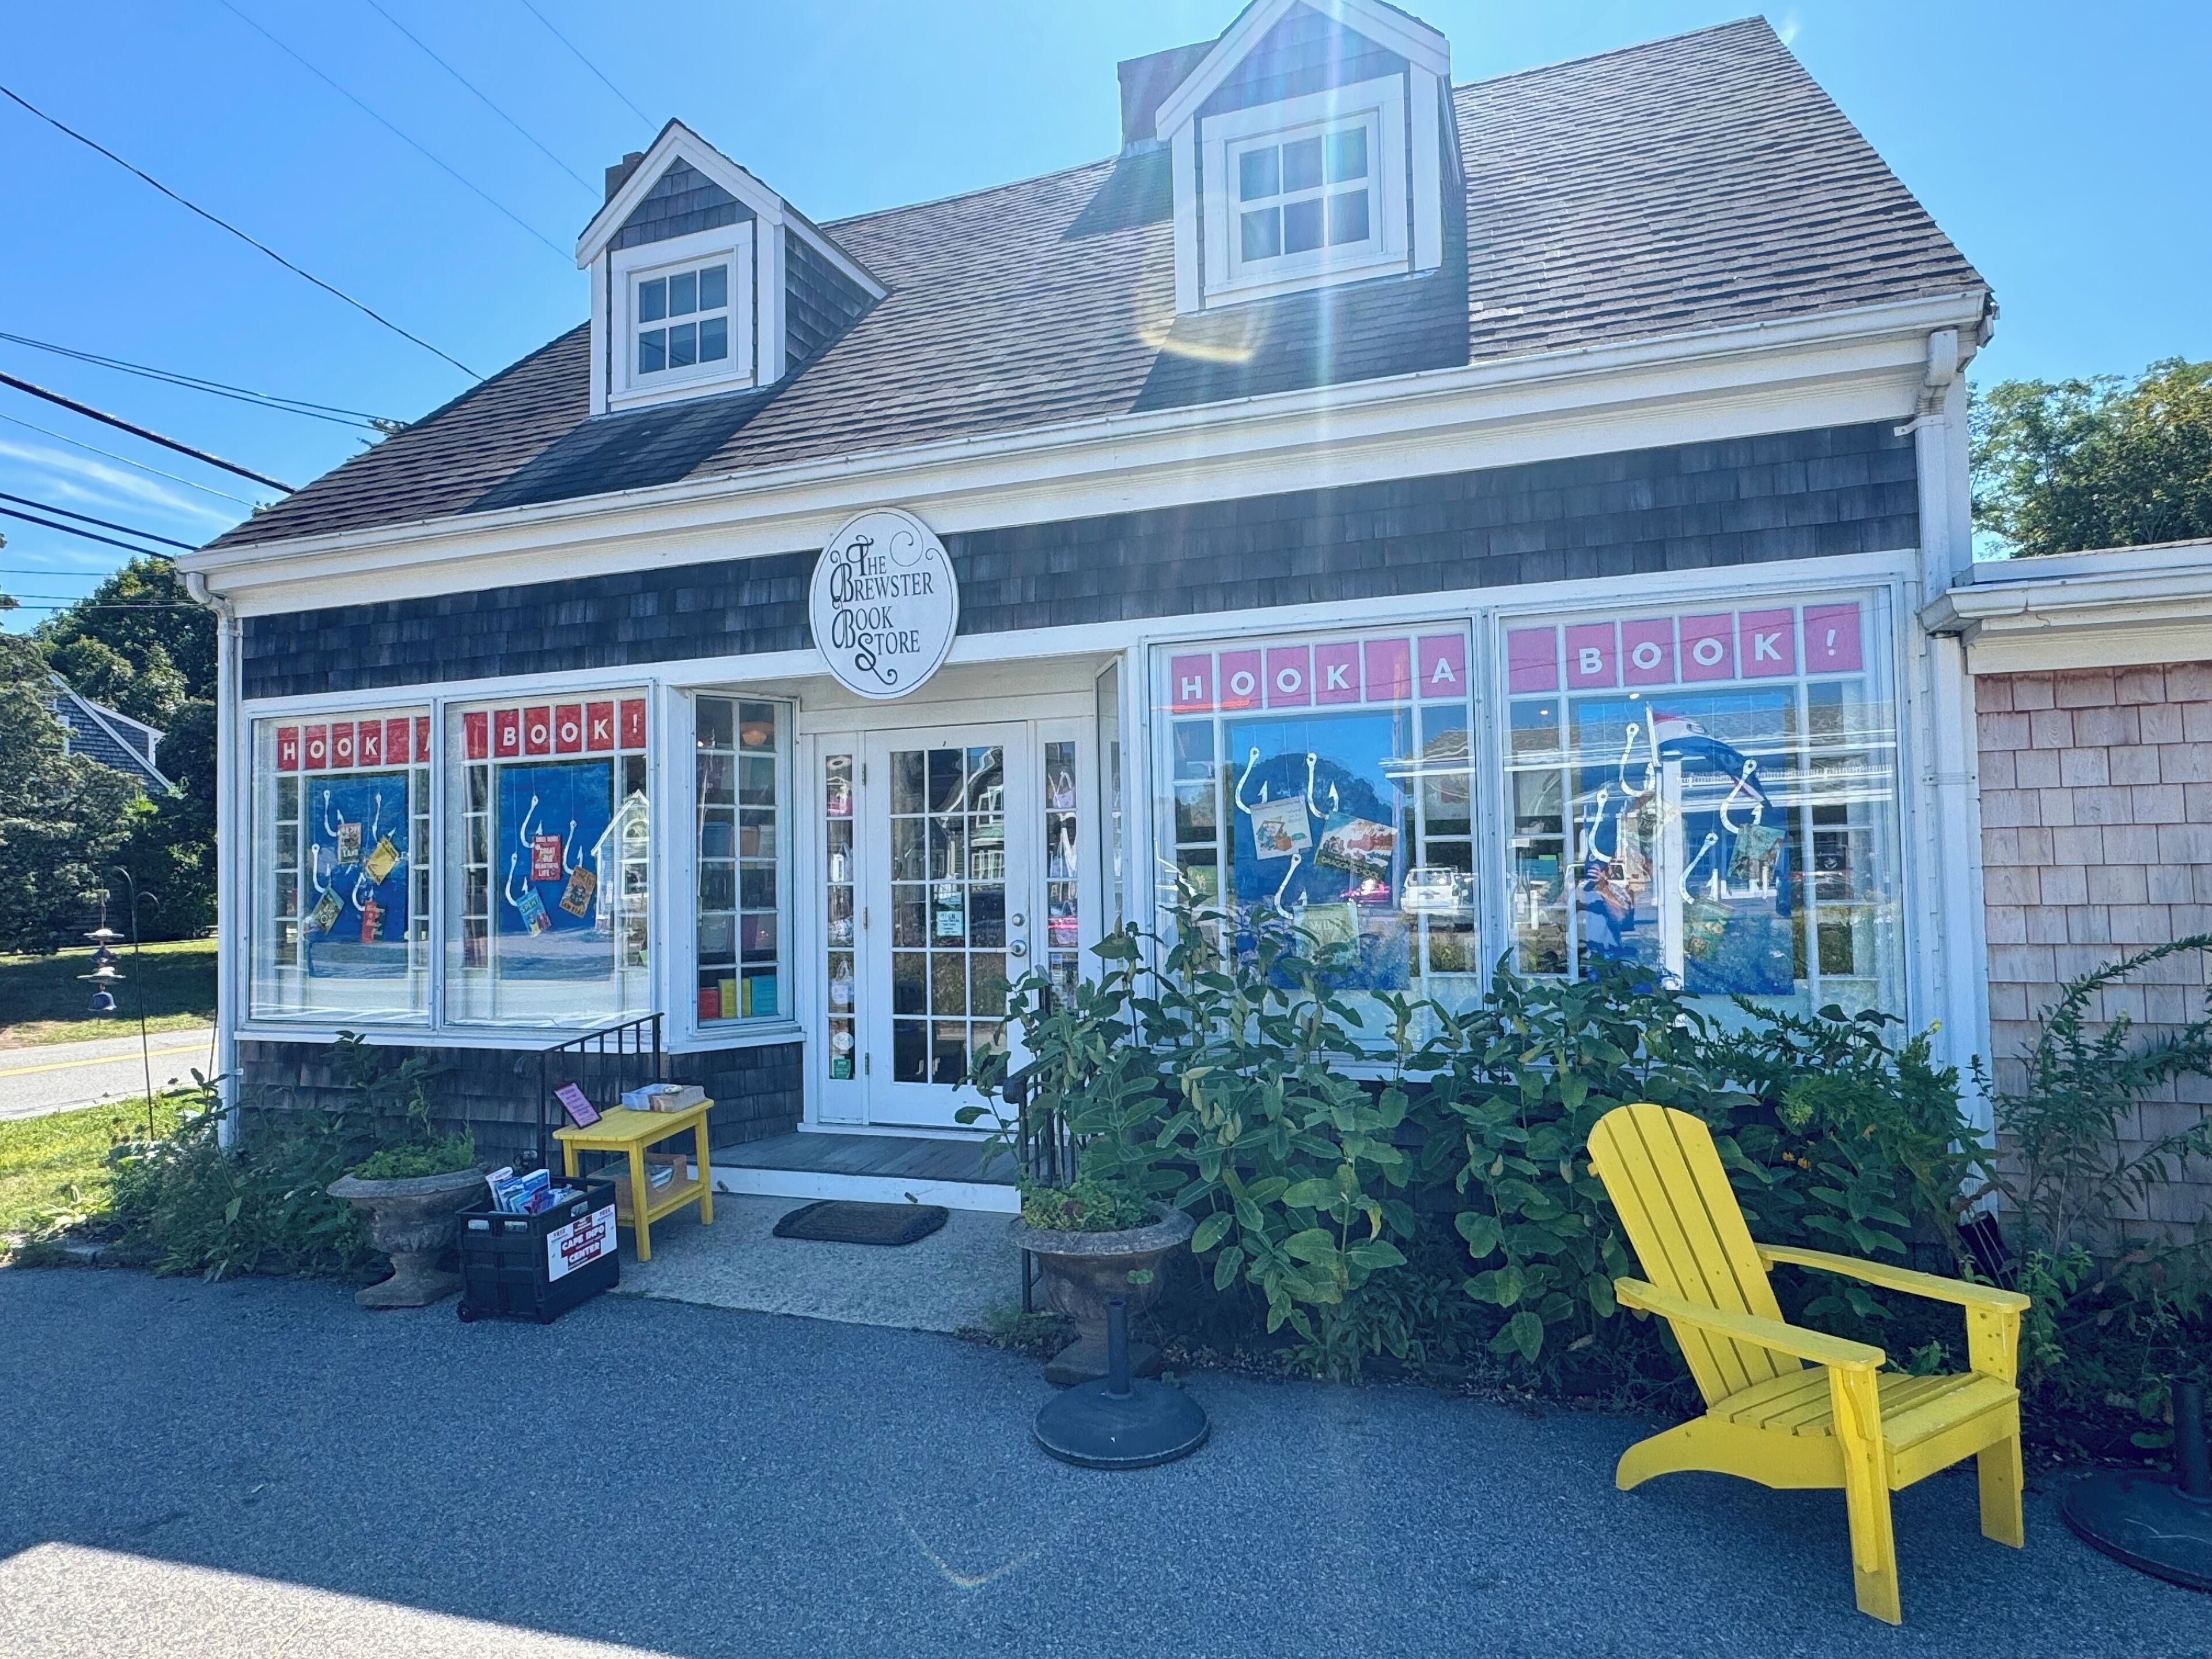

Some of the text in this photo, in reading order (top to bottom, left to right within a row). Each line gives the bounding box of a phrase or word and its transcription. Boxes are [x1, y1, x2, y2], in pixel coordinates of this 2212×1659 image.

[832, 600, 894, 649] BOOK
[855, 630, 921, 685] STORE
[1181, 657, 1456, 700] HOOK A
[283, 736, 378, 761] HOOK
